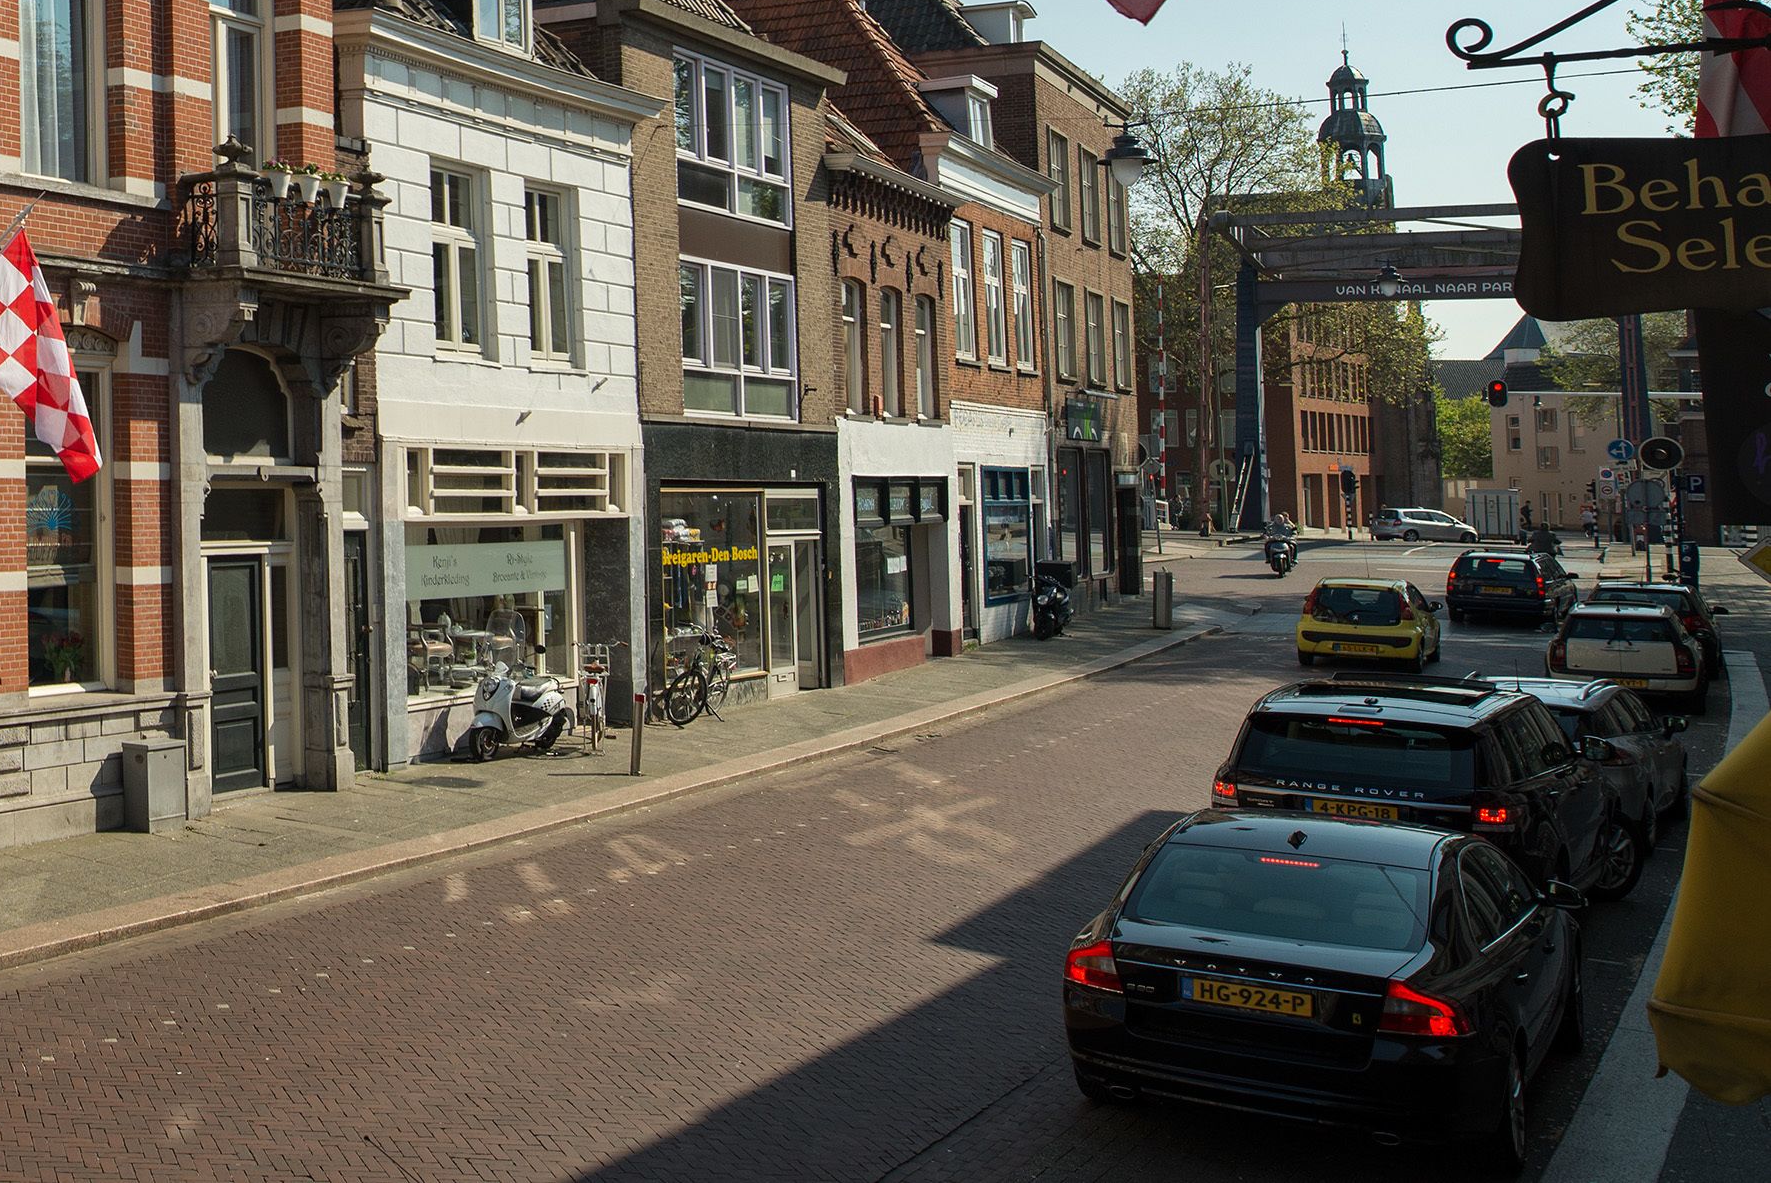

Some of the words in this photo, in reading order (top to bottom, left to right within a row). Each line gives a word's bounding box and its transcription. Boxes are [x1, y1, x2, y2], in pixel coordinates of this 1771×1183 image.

[1336, 285, 1366, 296] VAN
[1371, 283, 1430, 296] KNAAL
[1435, 282, 1477, 294] NAAR
[1482, 282, 1513, 293] PAR
[1690, 476, 1703, 491] P
[731, 545, 758, 562] Bosch
[421, 573, 470, 588] Kinderkleding
[1276, 779, 1340, 792] RANGE
[1354, 787, 1424, 799] ROVER
[1319, 800, 1391, 819] 4-KPG-18
[1199, 981, 1306, 1013] HG-924-P
